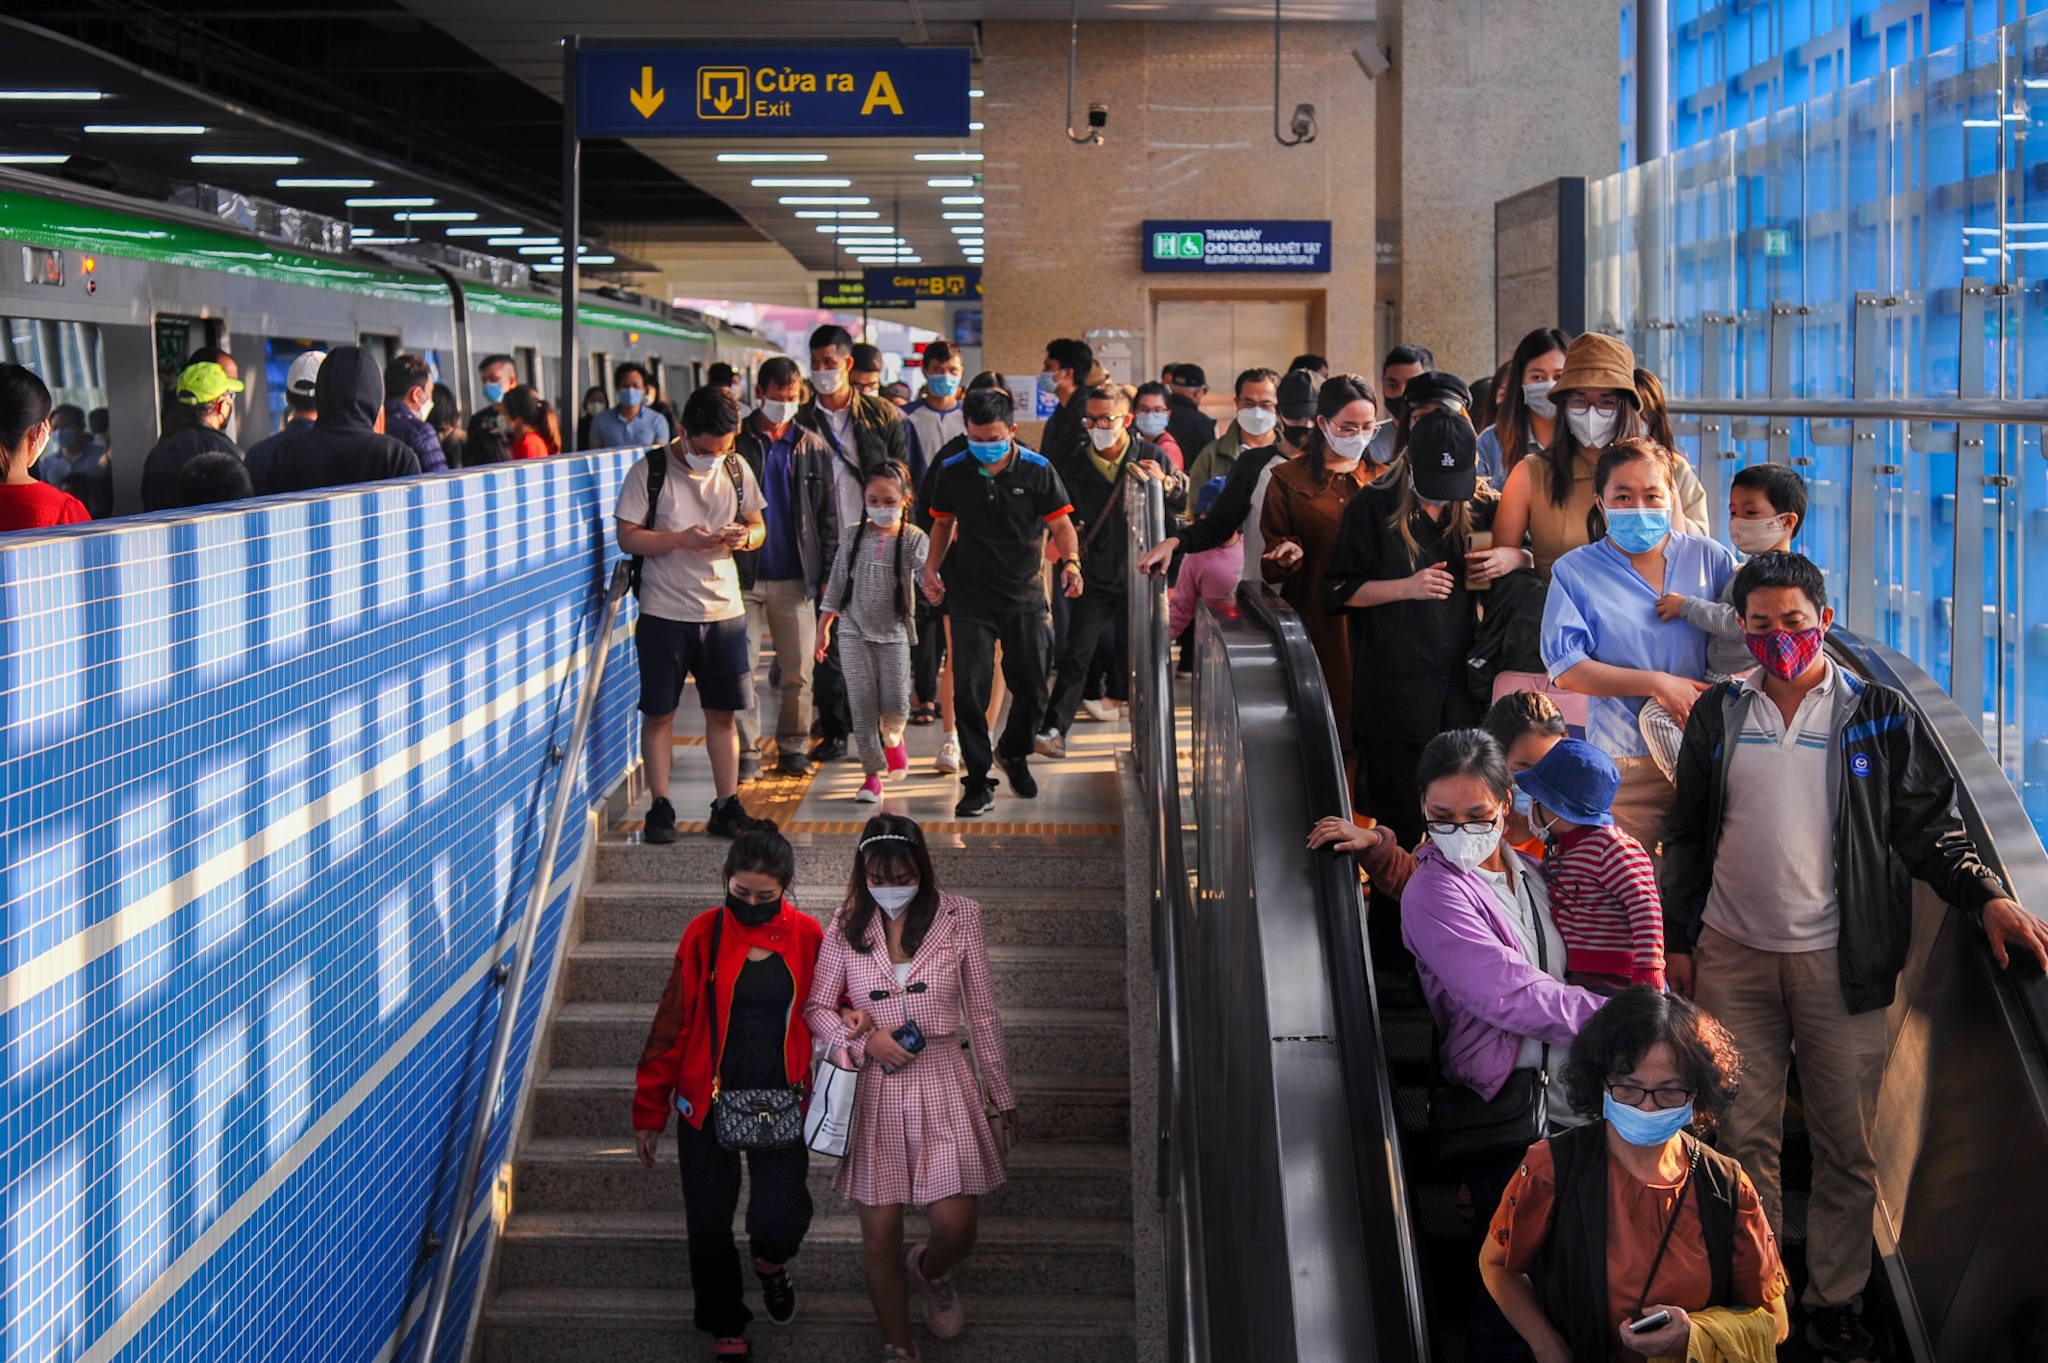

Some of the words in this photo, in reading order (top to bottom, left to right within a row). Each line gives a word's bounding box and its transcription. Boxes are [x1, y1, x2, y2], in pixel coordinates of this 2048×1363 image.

[755, 67, 817, 93] Cửa
[825, 73, 854, 92] ra
[860, 70, 904, 115] A
[755, 100, 791, 117] Exit
[930, 277, 945, 295] B
